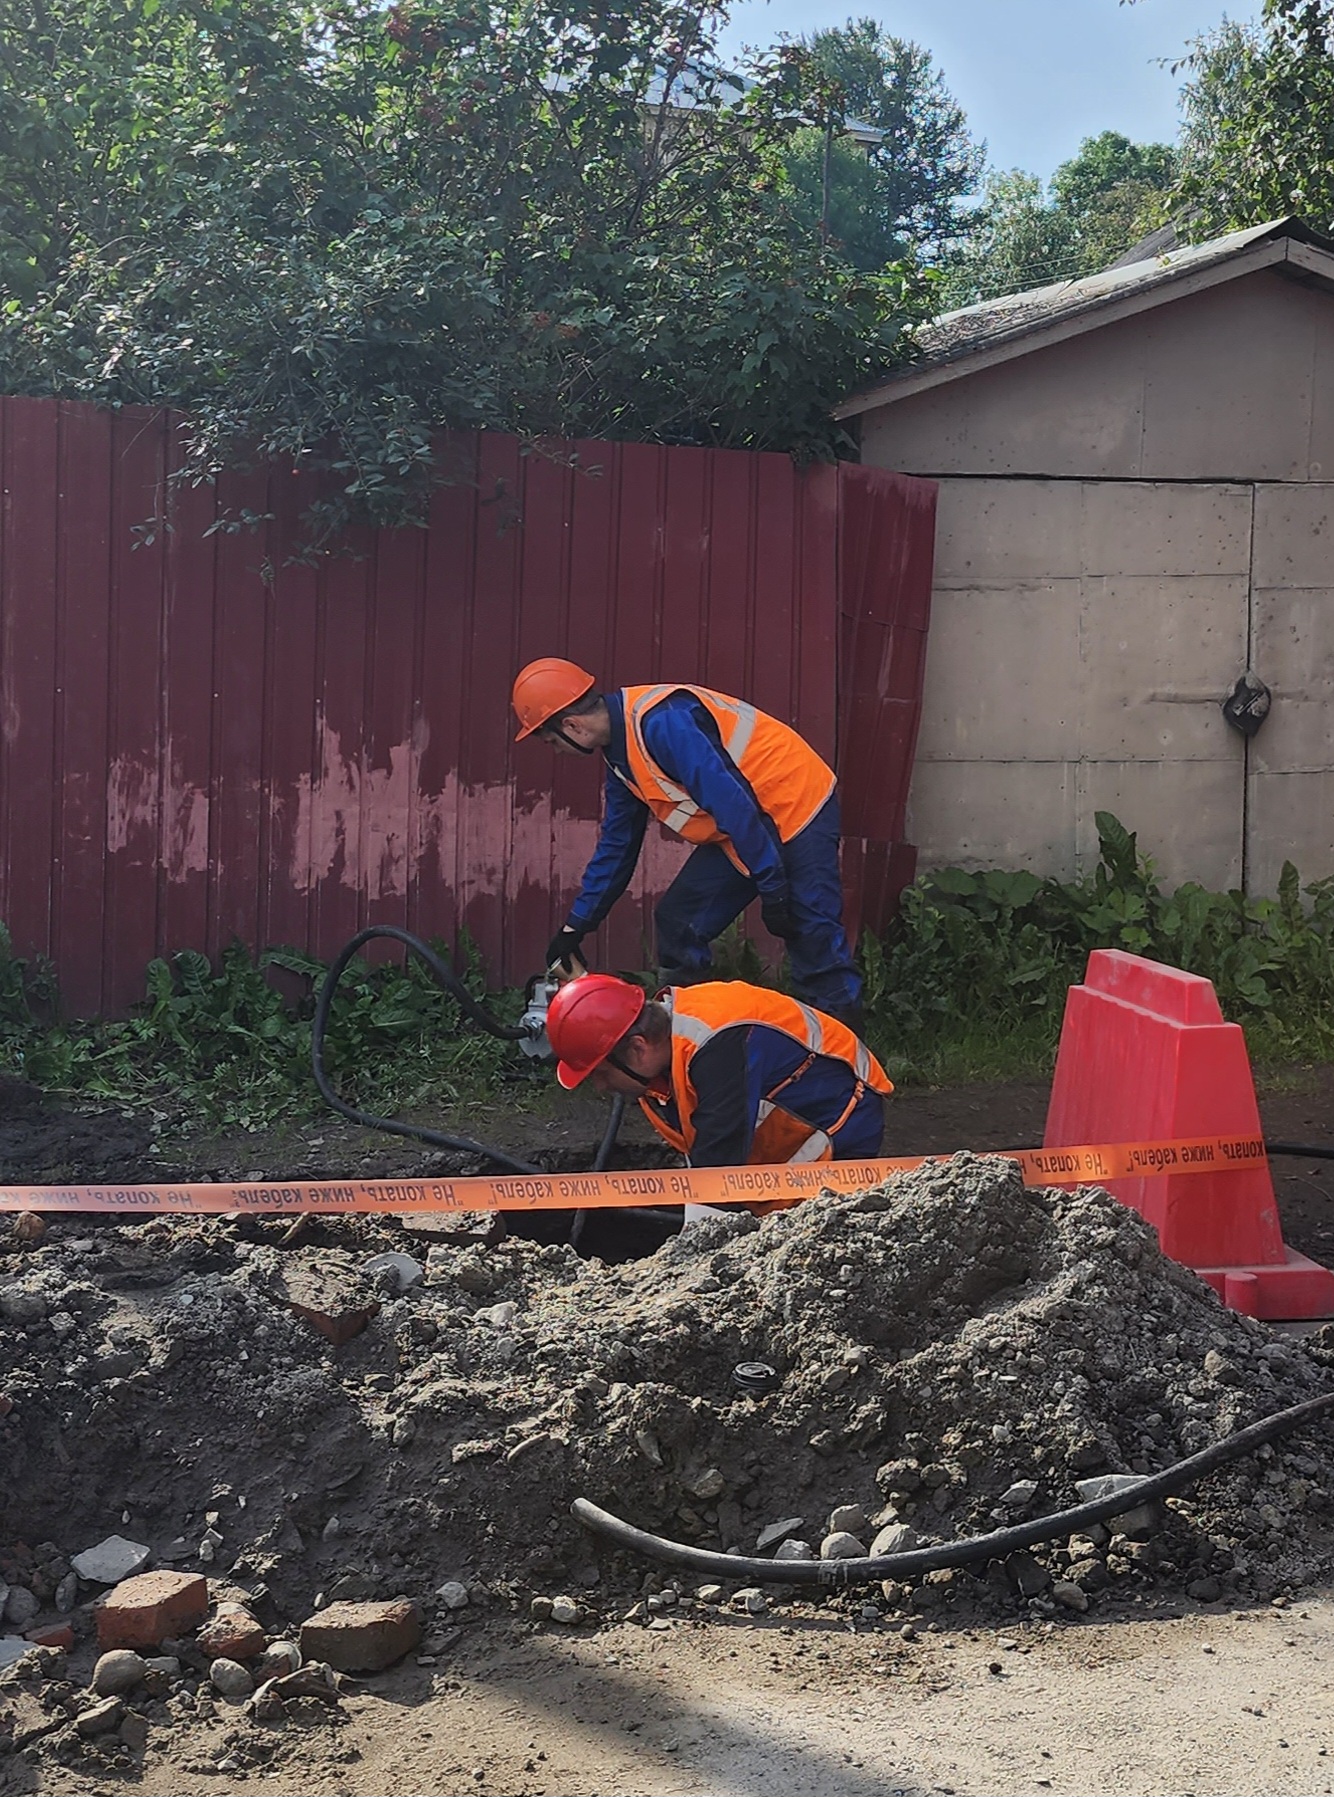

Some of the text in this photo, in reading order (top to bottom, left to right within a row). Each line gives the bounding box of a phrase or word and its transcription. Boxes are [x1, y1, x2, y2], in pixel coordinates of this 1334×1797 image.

[1182, 1145, 1214, 1162] ниже
[1030, 1153, 1081, 1174] копать,
[309, 1186, 356, 1202] ниже
[361, 1183, 426, 1202] копать,
[560, 1179, 602, 1197] ниже
[605, 1175, 665, 1195] копать,
[86, 1189, 161, 1206] копать,
